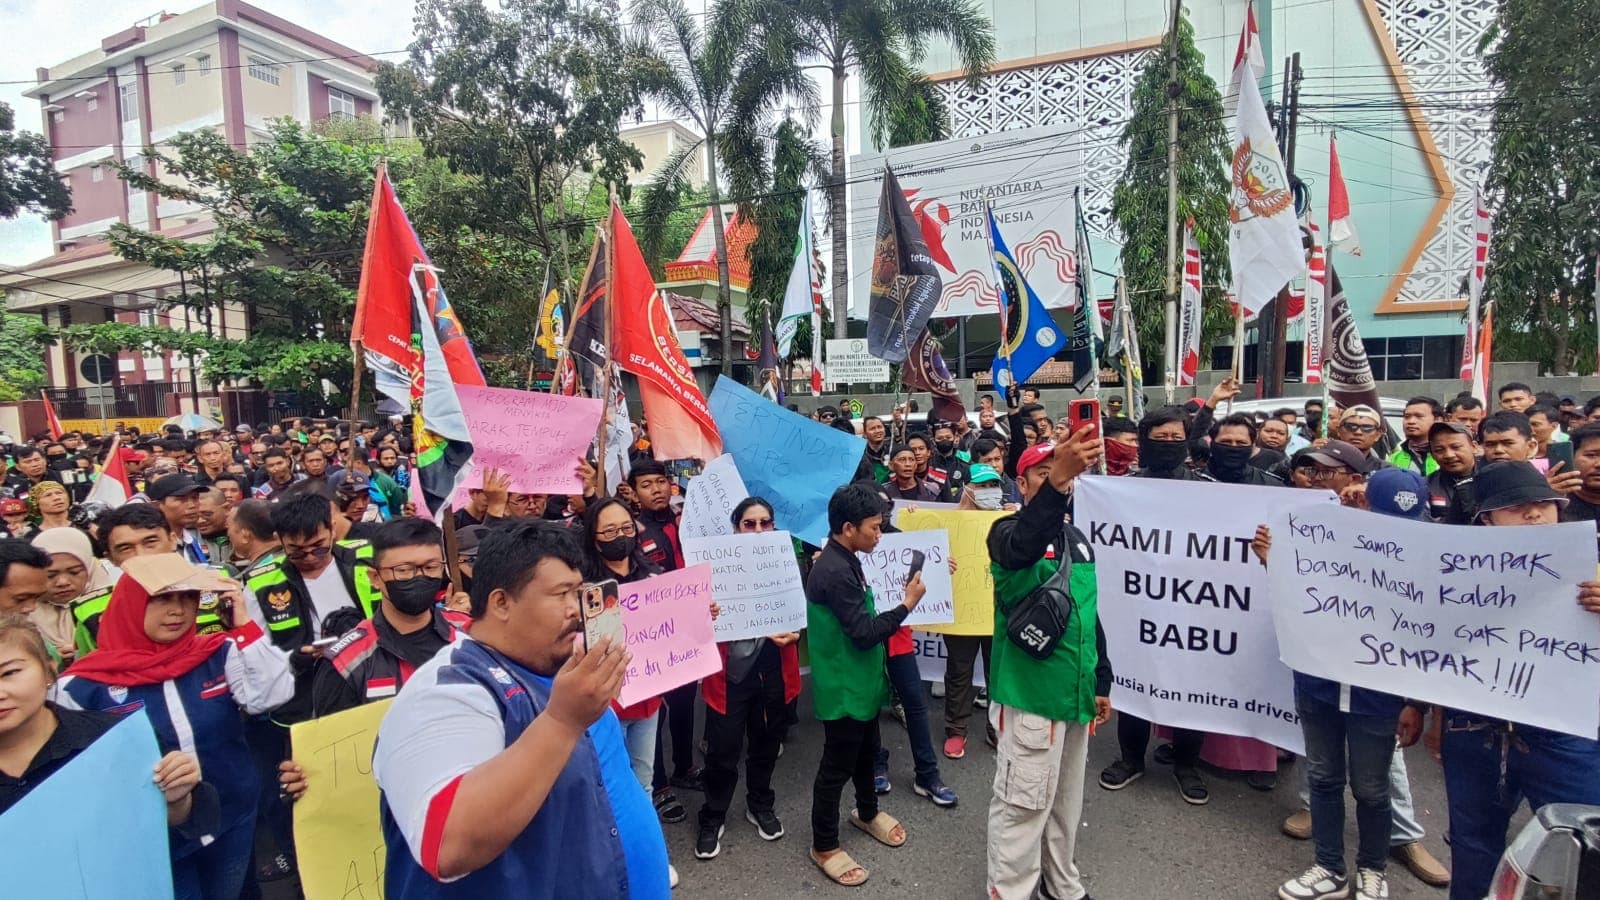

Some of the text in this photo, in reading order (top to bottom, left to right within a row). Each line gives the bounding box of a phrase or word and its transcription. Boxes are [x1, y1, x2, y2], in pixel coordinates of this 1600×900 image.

[961, 211, 1034, 229] INDNESIA
[961, 232, 987, 242] MA
[1311, 297, 1319, 365] DIRGAHAYU
[657, 335, 697, 384] BERSA
[1090, 520, 1255, 563] KAMI MIT
[712, 562, 746, 575] IKATOR
[862, 548, 897, 570] arga
[1124, 570, 1251, 612] BUKAN
[720, 603, 746, 617] EMO
[713, 622, 735, 633] RUT
[1139, 618, 1238, 656] BABU
[1149, 683, 1182, 702] kan
[1187, 691, 1239, 709] mitra
[1244, 699, 1301, 725] driver
